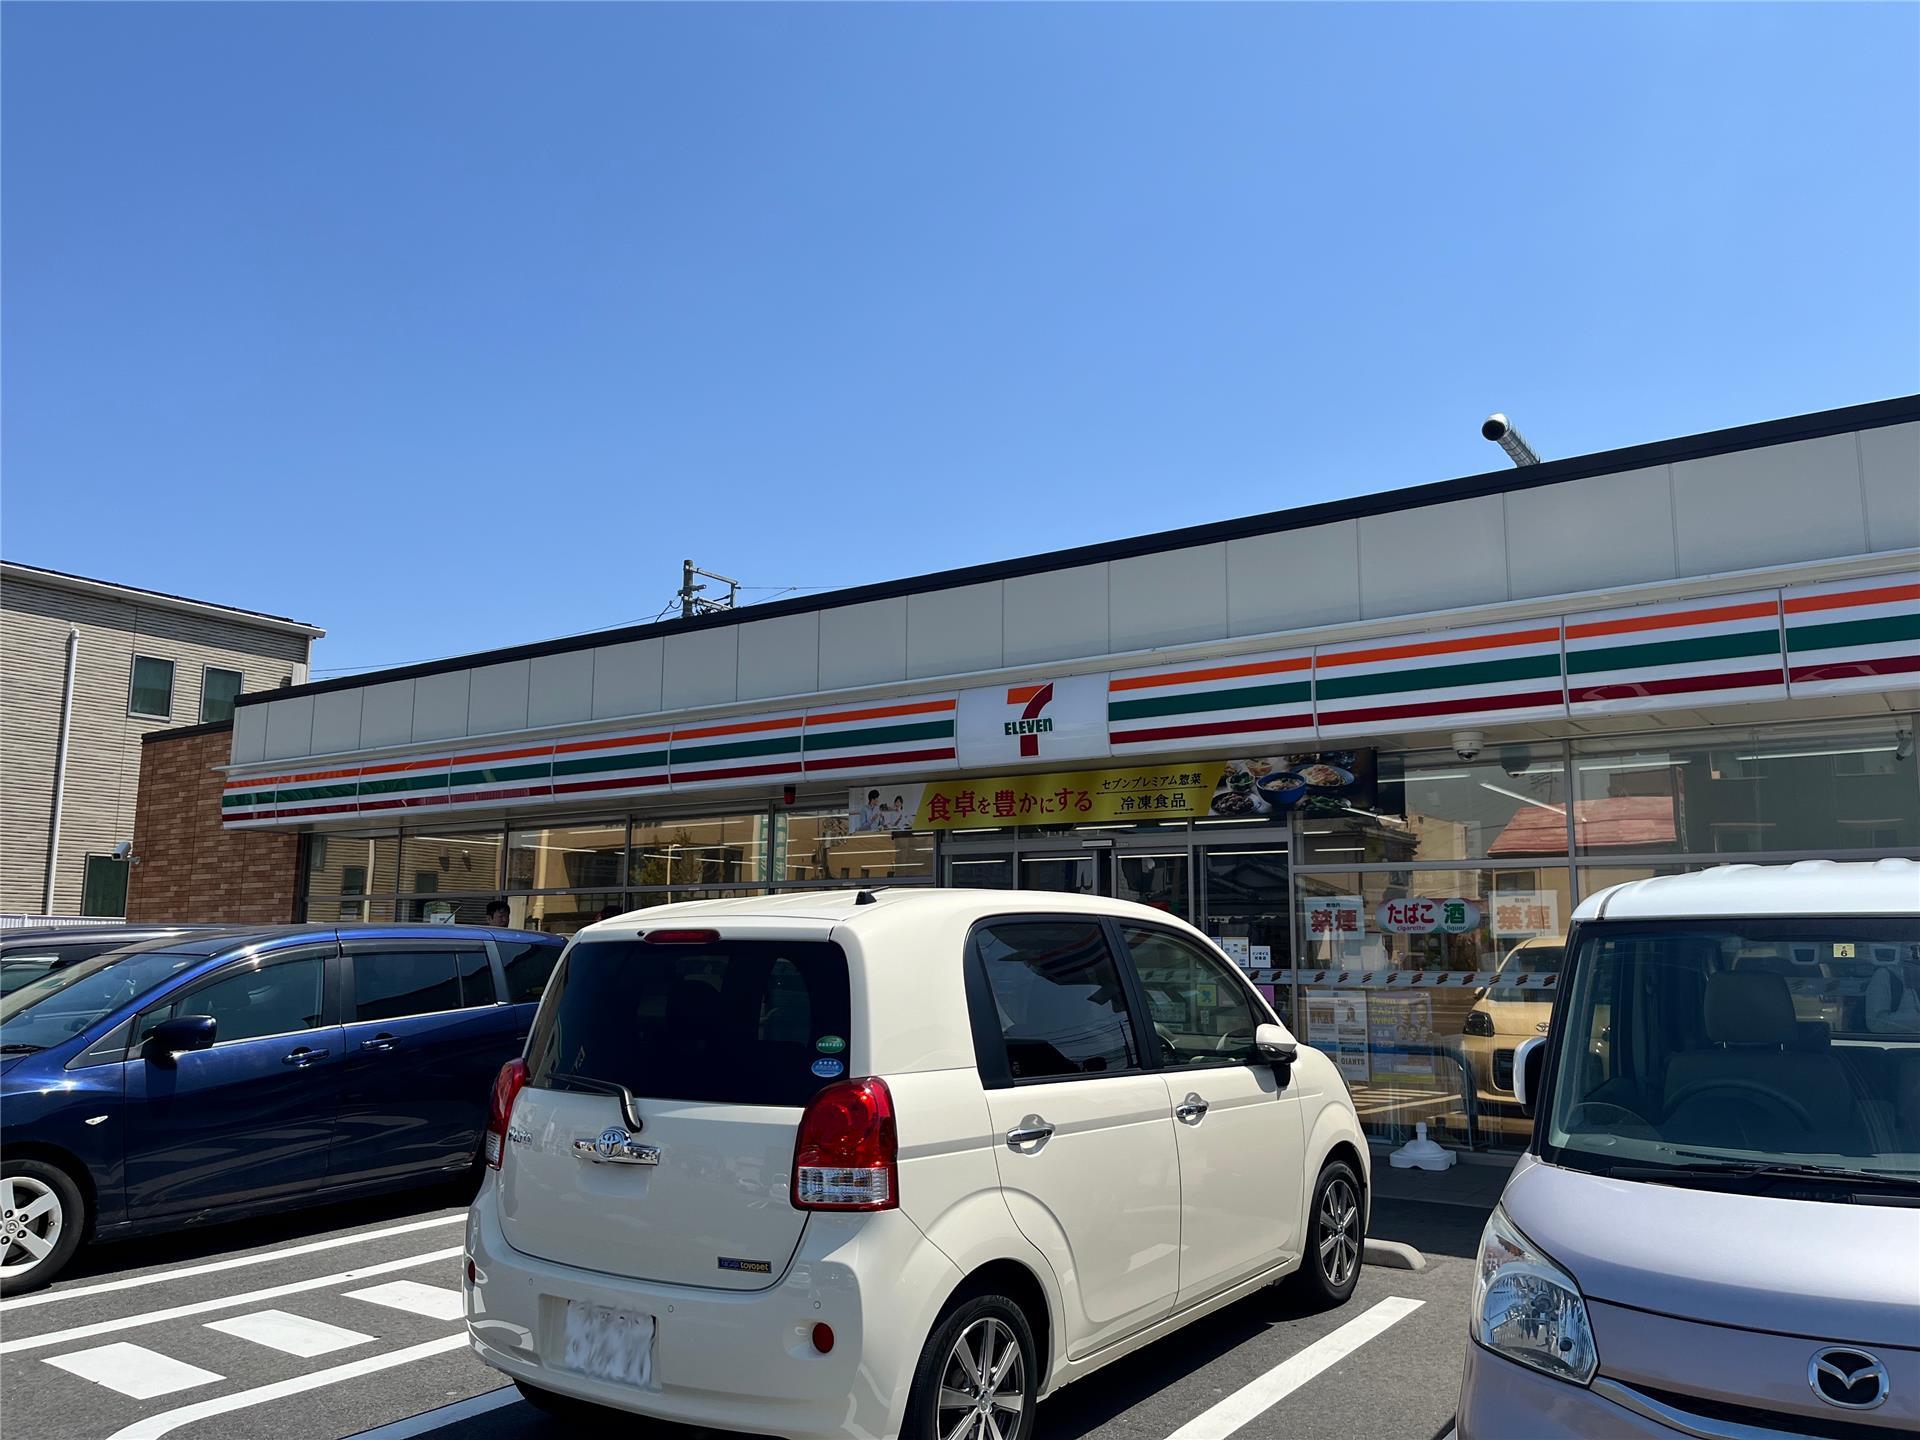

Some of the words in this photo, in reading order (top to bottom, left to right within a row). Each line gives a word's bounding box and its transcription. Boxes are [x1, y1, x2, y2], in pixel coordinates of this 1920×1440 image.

[1007, 682, 1053, 757] 7
[1102, 773, 1202, 790] セブンプレミアム惣菜
[928, 788, 1093, 823] 食卓を豊かにする
[1121, 793, 1186, 811] 冷凍食品
[1311, 908, 1358, 932] 禁煙
[1388, 903, 1435, 924] たばこ
[1444, 903, 1465, 924] 酒
[1496, 905, 1552, 929] 禁煙
[740, 1261, 769, 1271] toyopet
